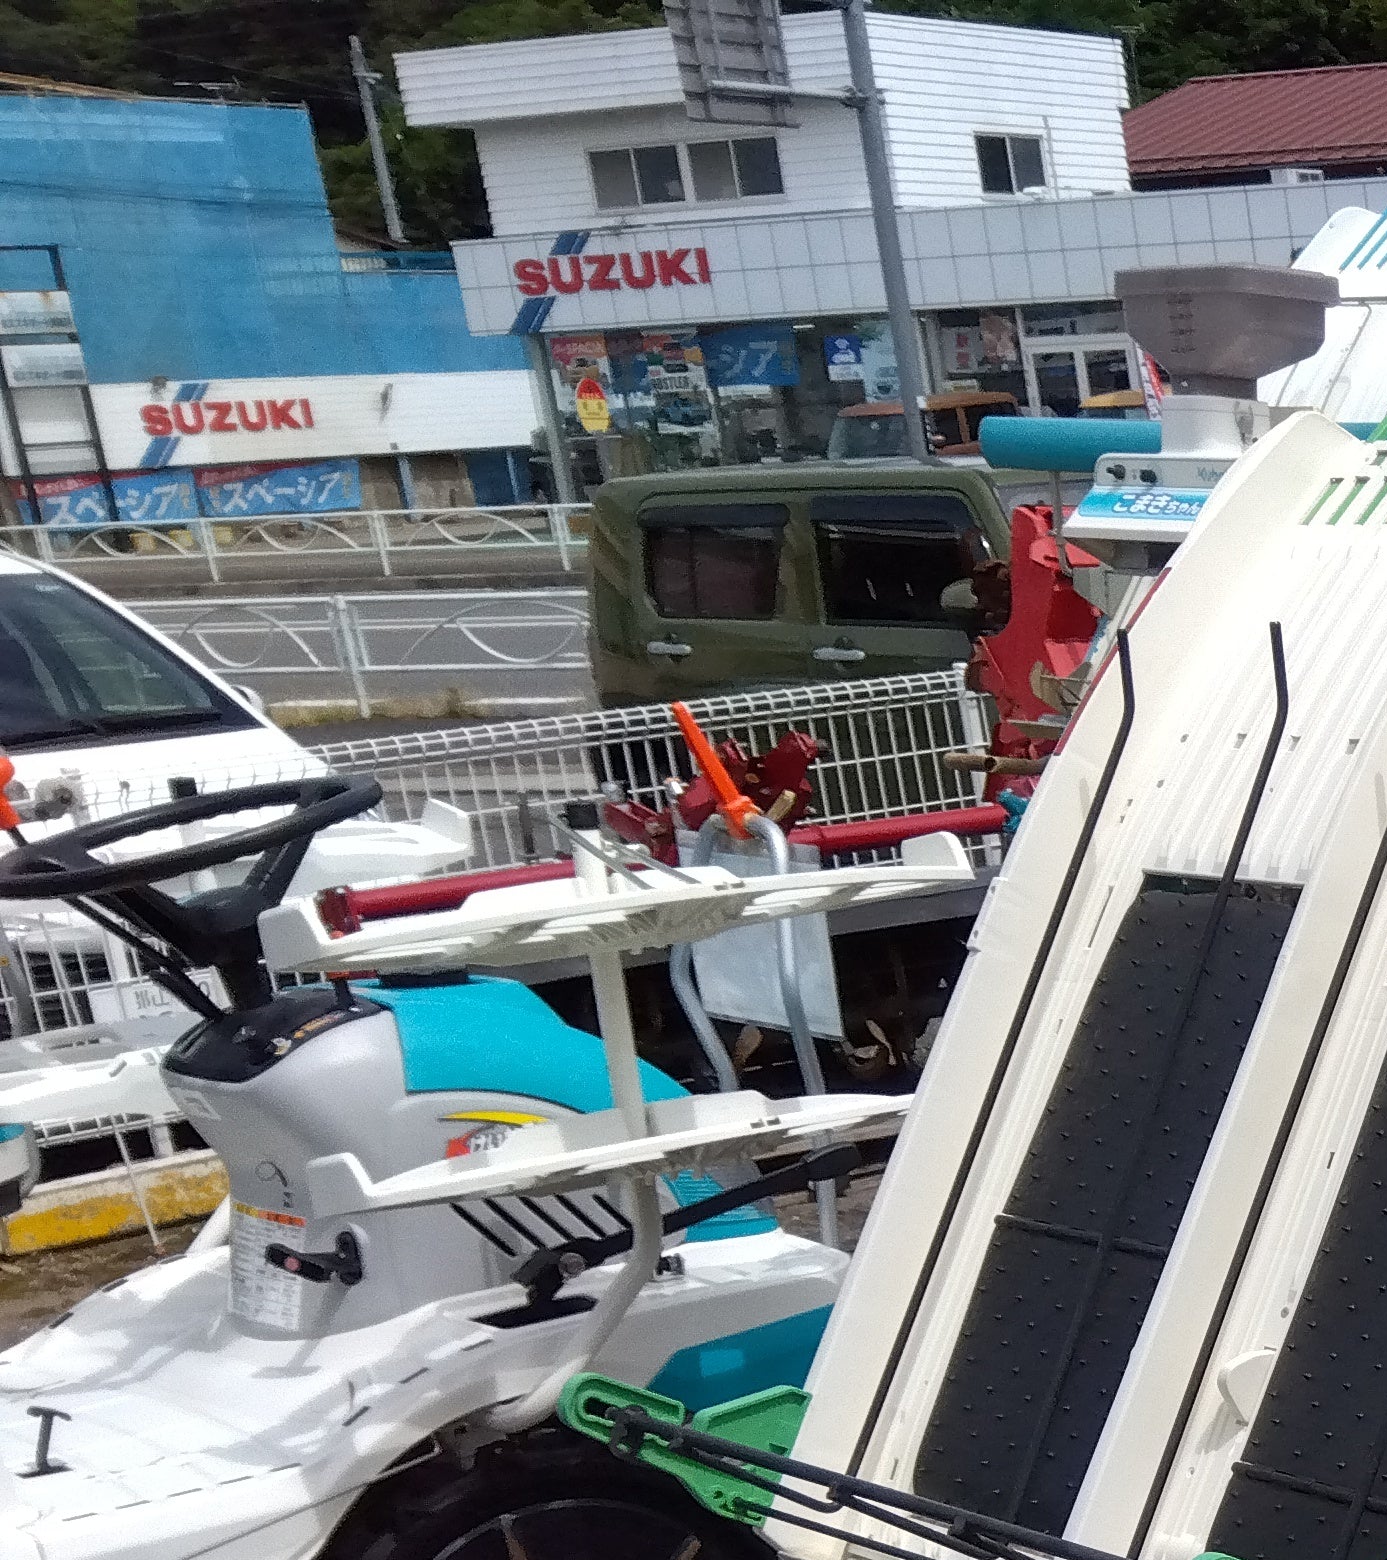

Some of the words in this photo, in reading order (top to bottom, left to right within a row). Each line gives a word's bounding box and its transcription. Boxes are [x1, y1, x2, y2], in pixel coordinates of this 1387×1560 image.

[513, 246, 712, 297] SUZUKI
[140, 397, 314, 437] SUZUKI
[224, 471, 341, 514] スペーシア
[1112, 493, 1202, 515] こまきちゃん
